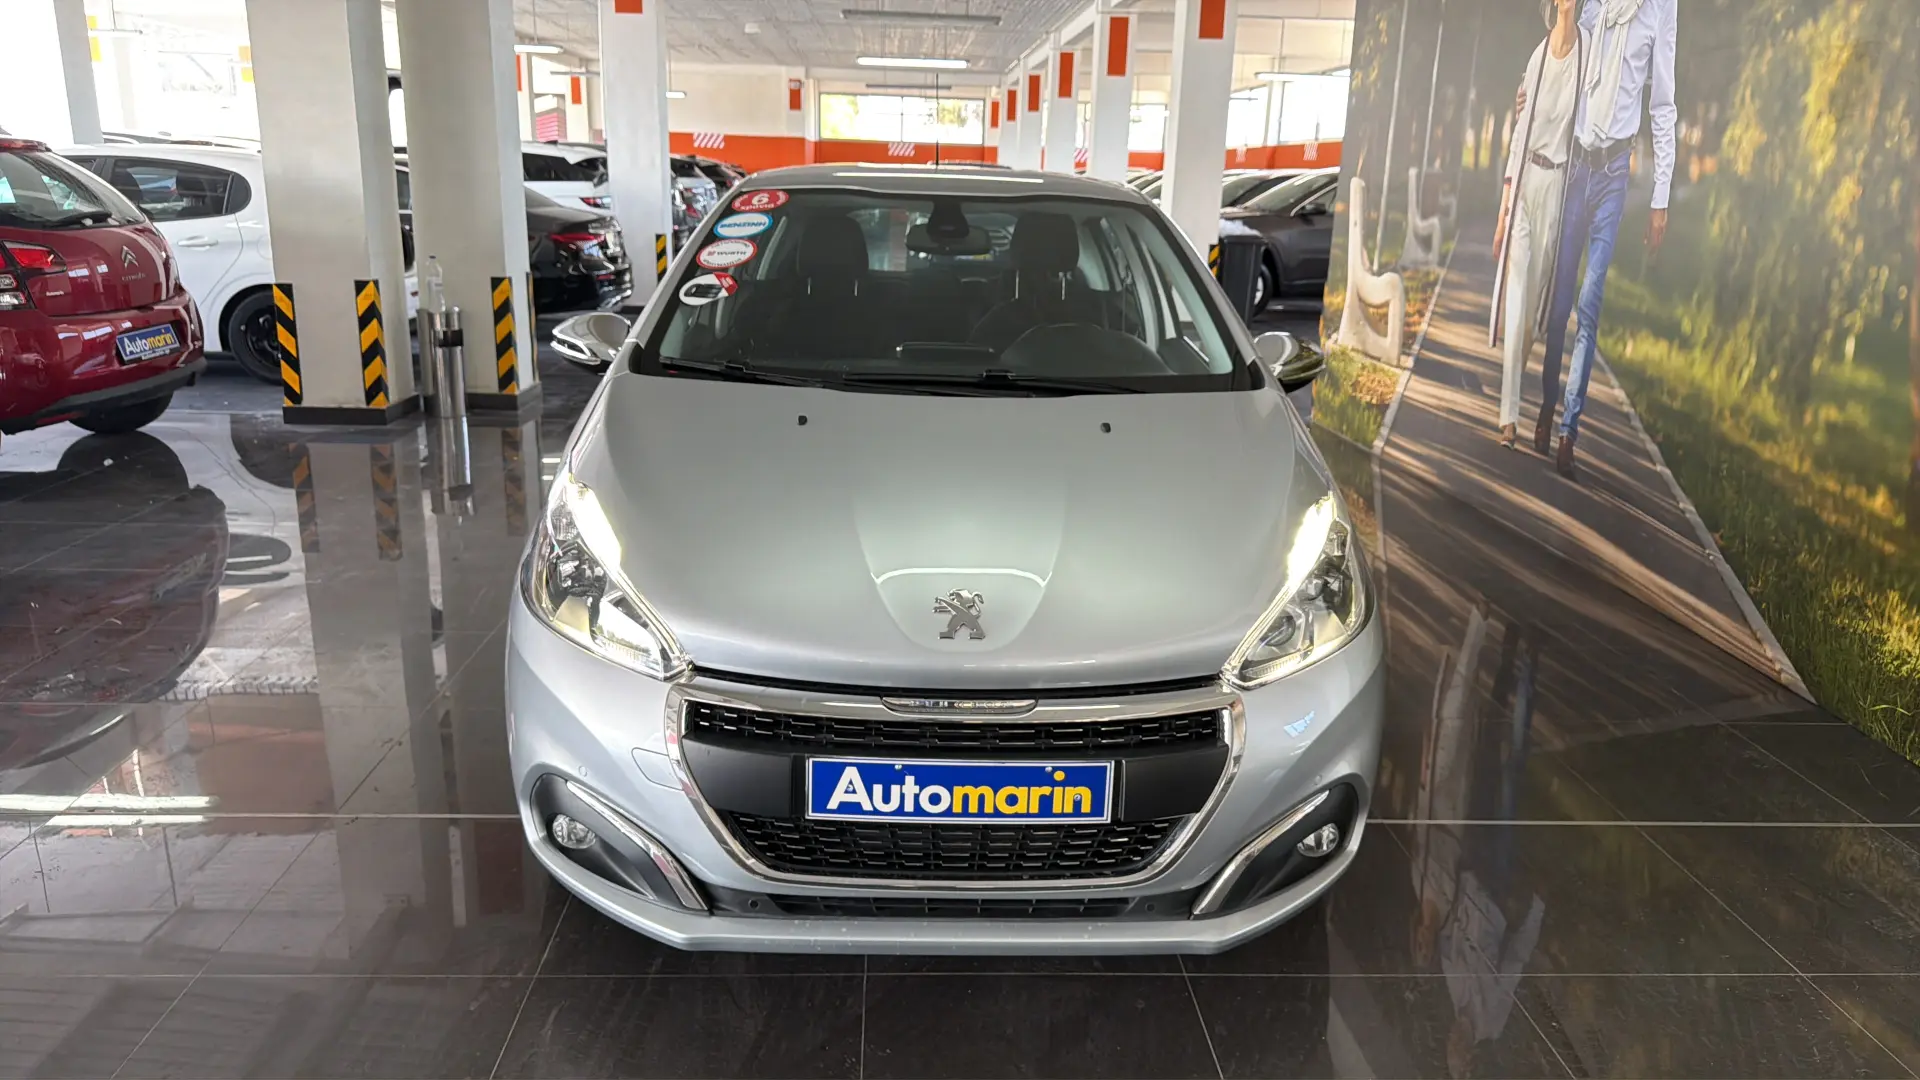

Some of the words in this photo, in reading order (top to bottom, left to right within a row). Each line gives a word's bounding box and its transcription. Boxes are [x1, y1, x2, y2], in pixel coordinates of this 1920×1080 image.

[751, 193, 770, 205] 6
[124, 329, 174, 355] Automarin
[826, 766, 1092, 814] Automarin
